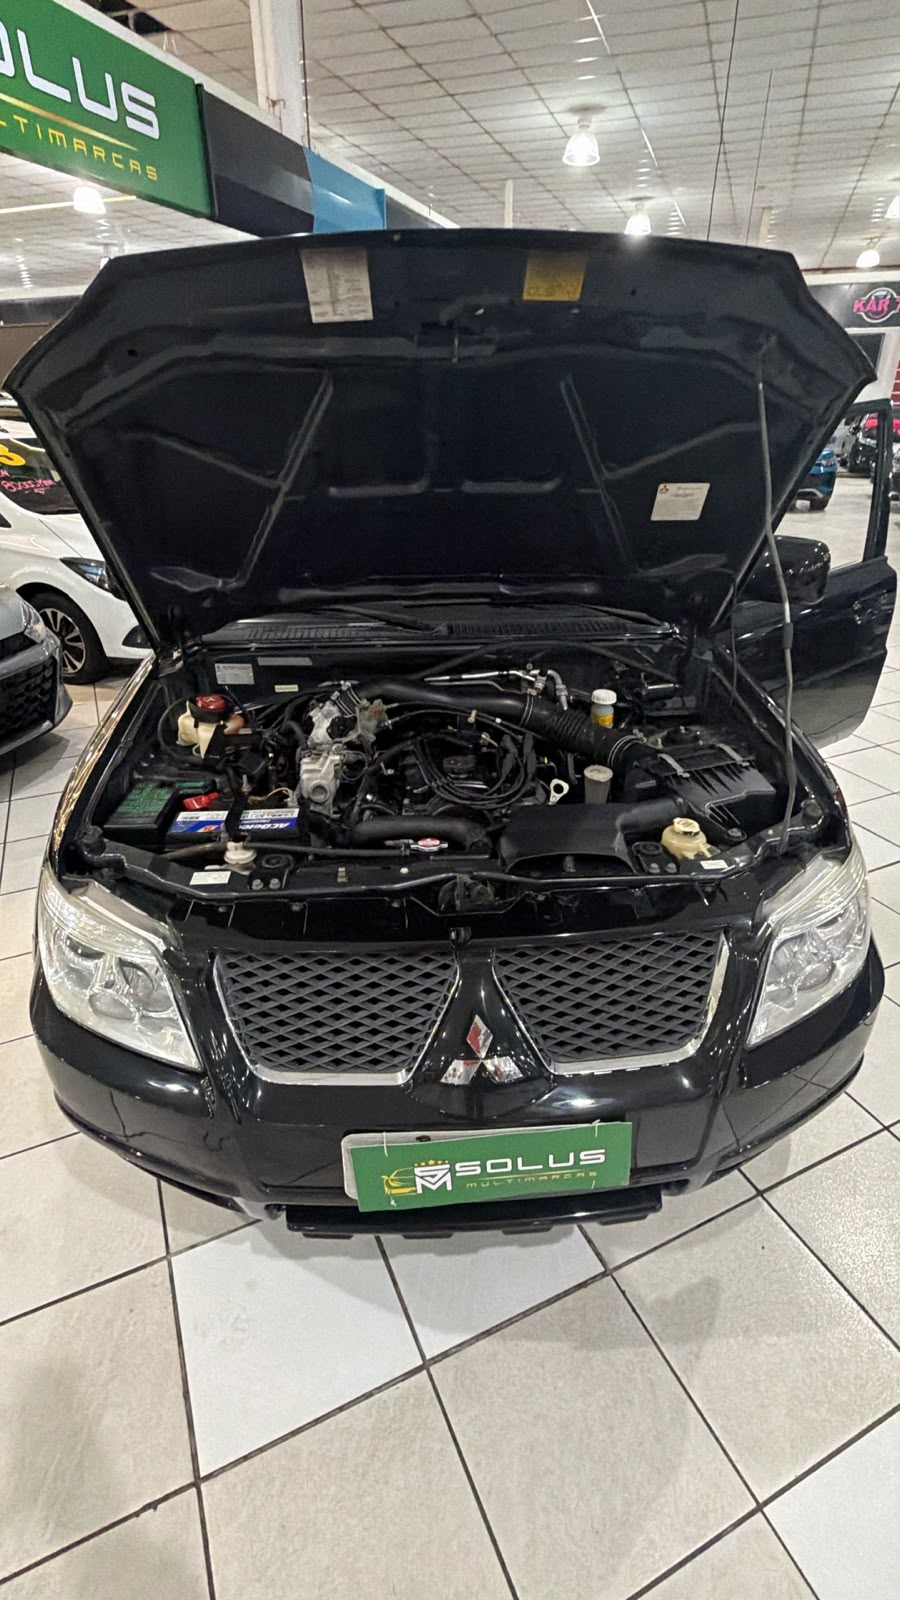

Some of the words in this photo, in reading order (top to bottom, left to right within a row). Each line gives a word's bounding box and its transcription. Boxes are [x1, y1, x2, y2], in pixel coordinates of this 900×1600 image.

[0, 20, 160, 140] LUS
[455, 1149, 606, 1177] SOLUS
[465, 1171, 598, 1188] MULTIMARCAS
